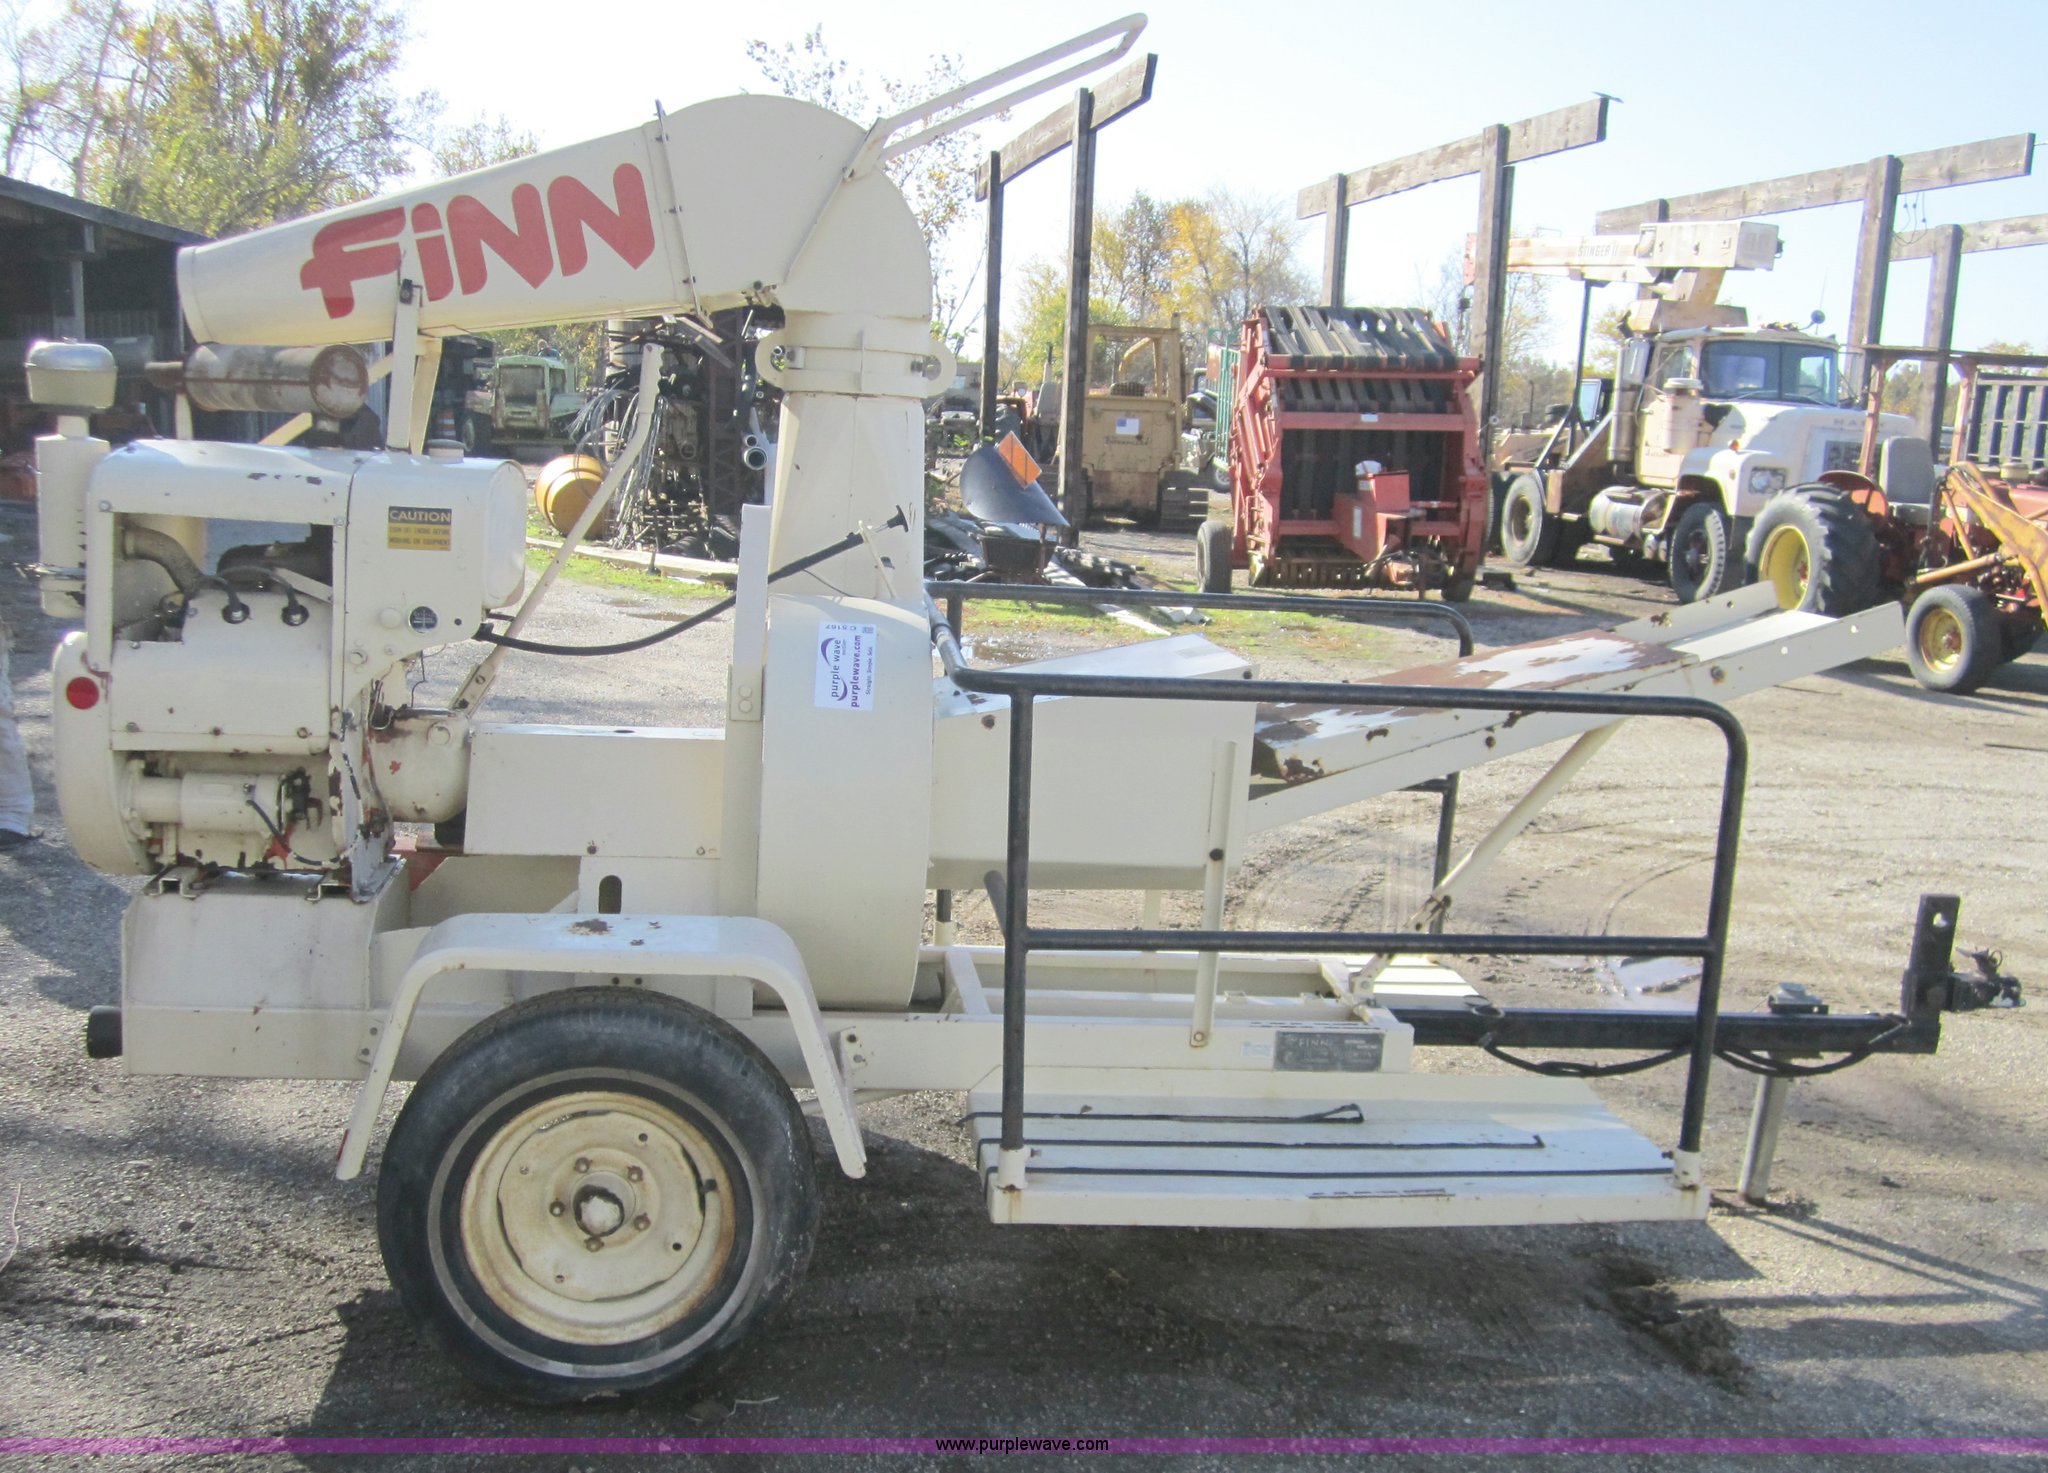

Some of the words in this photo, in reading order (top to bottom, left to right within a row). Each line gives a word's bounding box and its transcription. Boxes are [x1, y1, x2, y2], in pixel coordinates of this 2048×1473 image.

[389, 510, 451, 522] CAUTION
[831, 665, 841, 698] purple
[850, 635, 861, 708] purplewave.com
[1299, 1038, 1330, 1047] FINN
